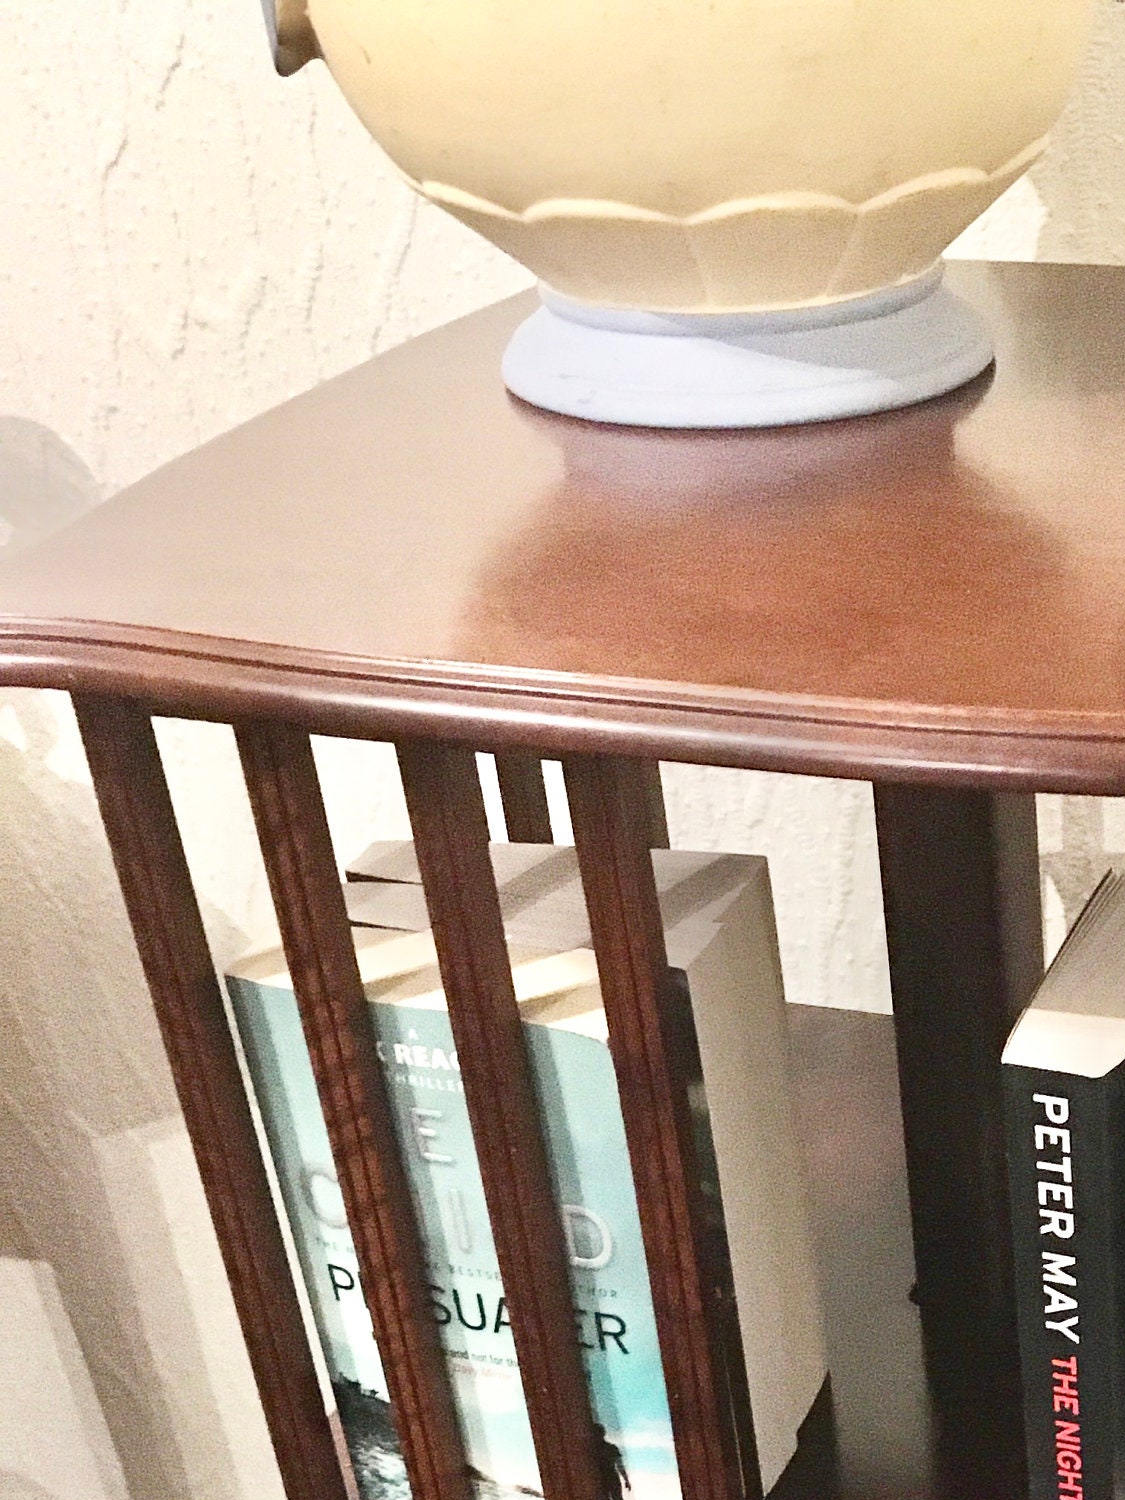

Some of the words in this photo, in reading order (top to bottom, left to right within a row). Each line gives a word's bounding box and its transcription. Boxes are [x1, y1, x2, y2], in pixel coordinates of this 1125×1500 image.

[393, 1043, 461, 1071] REAC
[1032, 1093, 1075, 1239] PETER
[1041, 1251, 1080, 1345] MAY
[1051, 1356, 1080, 1416] THE
